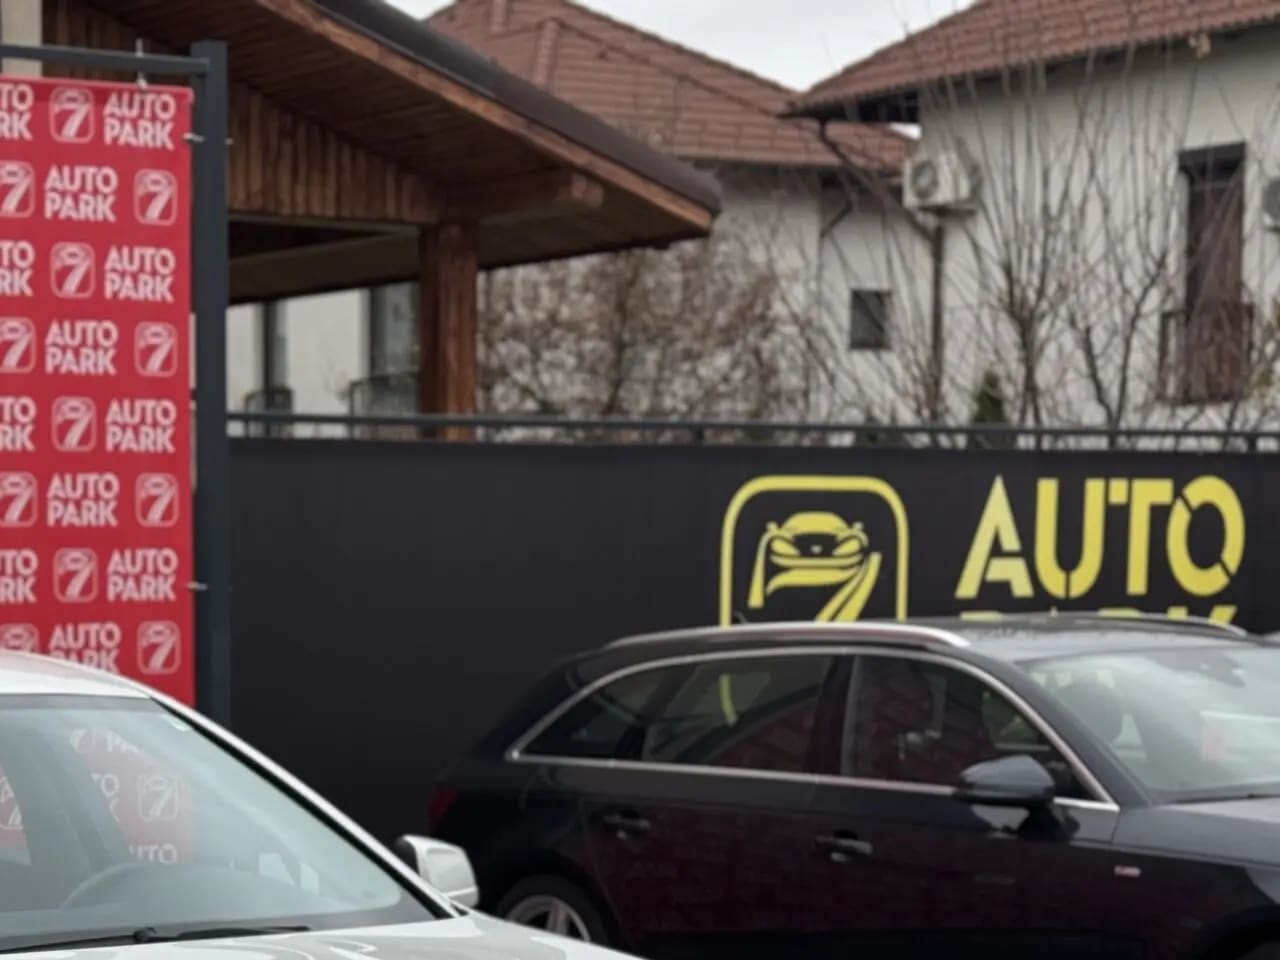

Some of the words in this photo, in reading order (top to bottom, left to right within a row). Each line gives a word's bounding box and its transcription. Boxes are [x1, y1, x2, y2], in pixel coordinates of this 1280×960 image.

[103, 93, 175, 120] AUTO
[104, 117, 173, 149] PARK
[44, 166, 118, 194] AUTO
[44, 191, 115, 221] PARK
[104, 247, 175, 275] AUTO
[104, 271, 173, 301] PARK
[45, 320, 119, 347] AUTO
[45, 346, 116, 374] PARK
[106, 399, 176, 426] AUTO
[106, 425, 174, 452] PARK
[47, 473, 119, 500] AUTO
[47, 499, 117, 526] PARK
[955, 475, 1245, 599] AUTO
[107, 548, 178, 575] AUTO
[107, 574, 175, 601] PARK
[47, 621, 121, 651] AUTO
